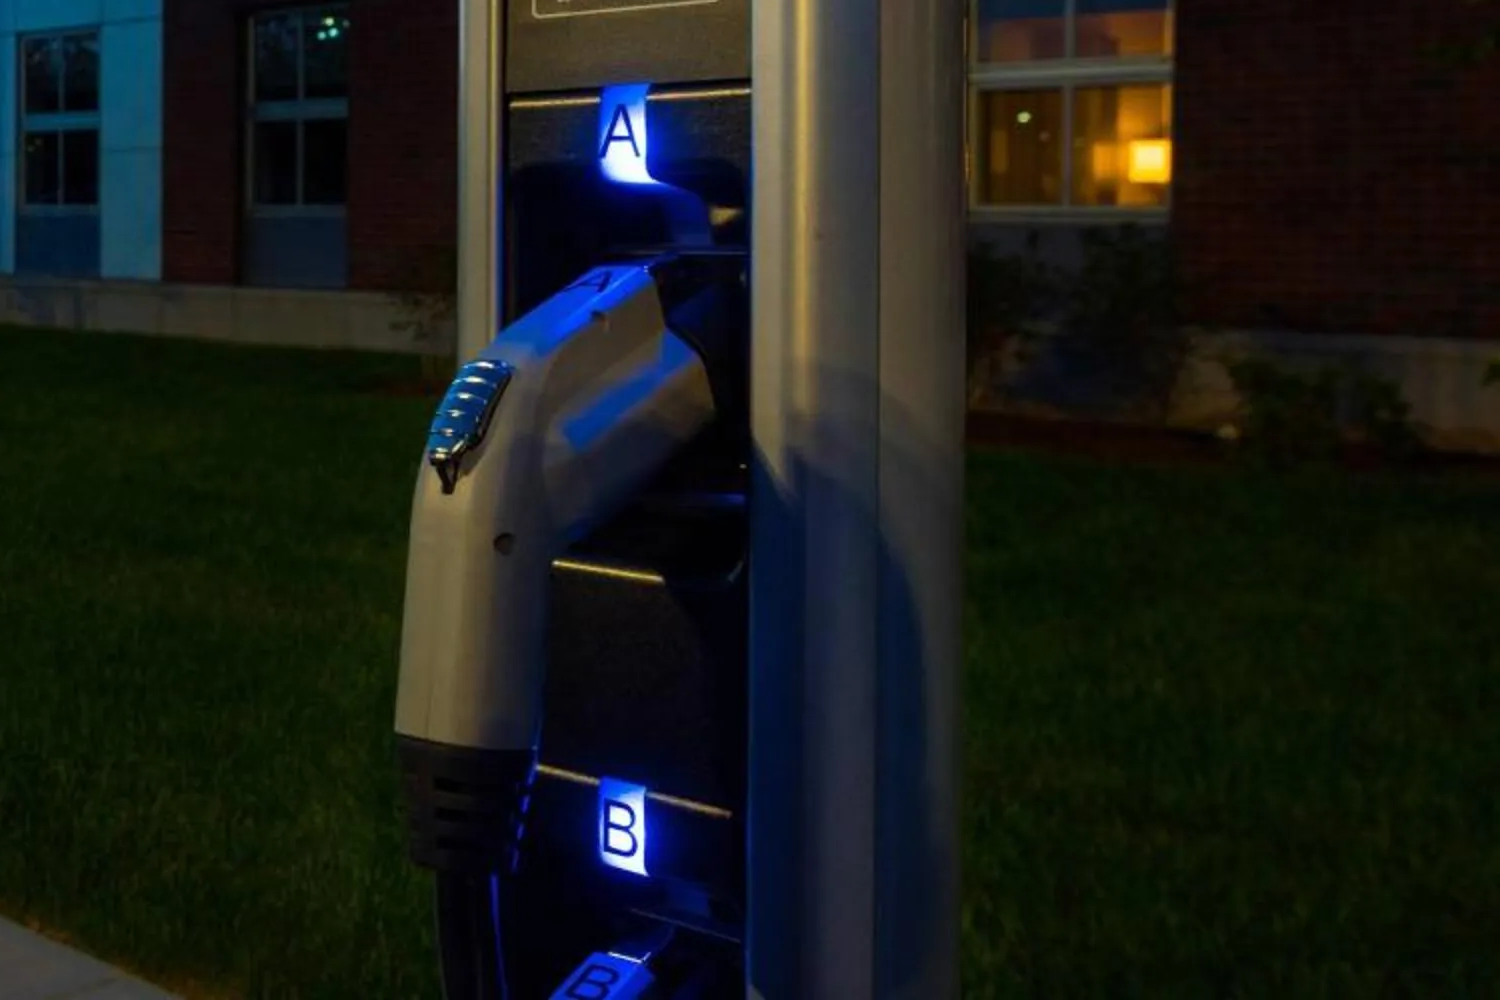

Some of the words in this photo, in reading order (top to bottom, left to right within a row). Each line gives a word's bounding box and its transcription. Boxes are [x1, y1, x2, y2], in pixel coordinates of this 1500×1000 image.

[598, 103, 641, 159] A
[604, 799, 638, 859] B
[565, 964, 620, 1000] B
